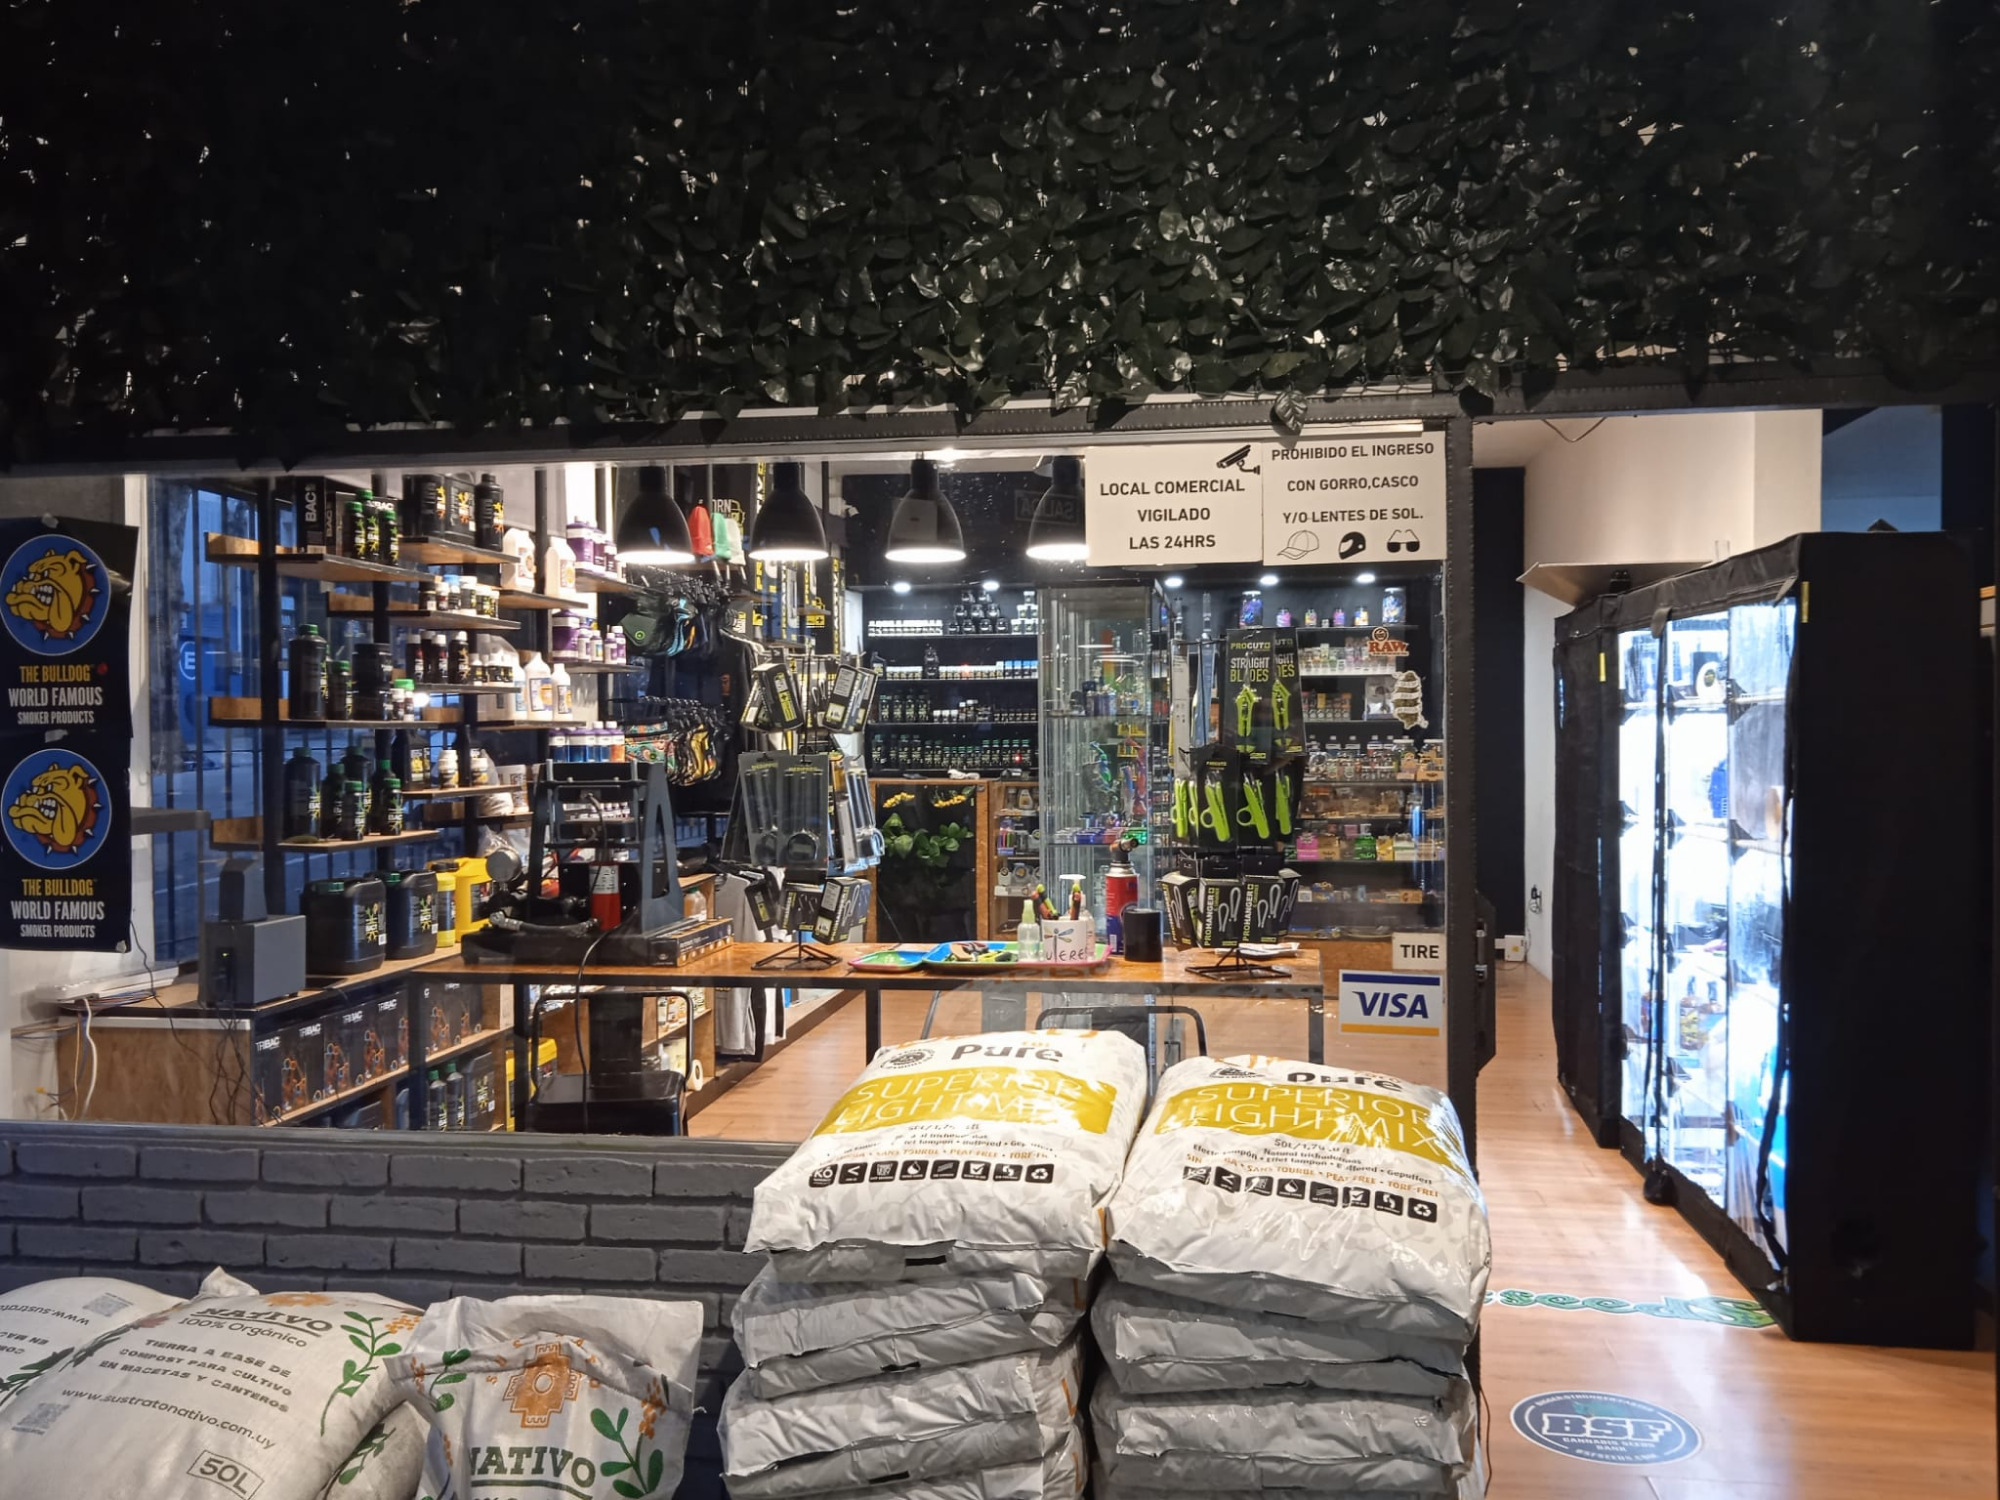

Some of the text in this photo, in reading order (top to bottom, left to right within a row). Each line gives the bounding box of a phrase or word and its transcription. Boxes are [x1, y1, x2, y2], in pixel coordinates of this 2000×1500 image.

[1271, 442, 1434, 461] PROHIBIDO EL INGRESO
[1100, 479, 1245, 496] LOCAL COMERCIAL
[1287, 475, 1419, 492] CON GORRO,CASCO
[1137, 507, 1211, 522] VIGILADO
[1283, 508, 1424, 524] Y/O LENTES DE SOL.
[1129, 534, 1217, 550] LAS 24HRS
[1369, 641, 1408, 653] RAW
[19, 664, 91, 682] THE BULLDOG
[1230, 669, 1270, 683] BLDES
[8, 686, 103, 707] WORLD FAMOUS
[17, 710, 94, 725] SMOKER PRODUCTS
[22, 878, 94, 896] THE BULLDOG
[11, 900, 105, 920] WORLD FAMOUS
[20, 924, 96, 938] SMOKER PRODUCTS
[1400, 944, 1439, 959] TIRE
[1352, 991, 1429, 1019] VISA
[1198, 1085, 1432, 1123] SUPERIOR
[1189, 1103, 1333, 1131] LIGHT
[199, 1307, 333, 1334] NATIVO
[178, 1317, 308, 1348] 100% Orgánico
[145, 1339, 198, 1354] TIERRA
[203, 1348, 215, 1356] A
[268, 1363, 291, 1378] DE
[119, 1348, 292, 1397] COMPOST PARA CULTIVO
[99, 1360, 290, 1413] EN MACETAS Y CANTEROS
[62, 1388, 277, 1450] www.sustratonativo.com.uy
[1541, 1412, 1672, 1443] BSF
[199, 1456, 248, 1496] 50L
[469, 1446, 596, 1488] NATIVO
